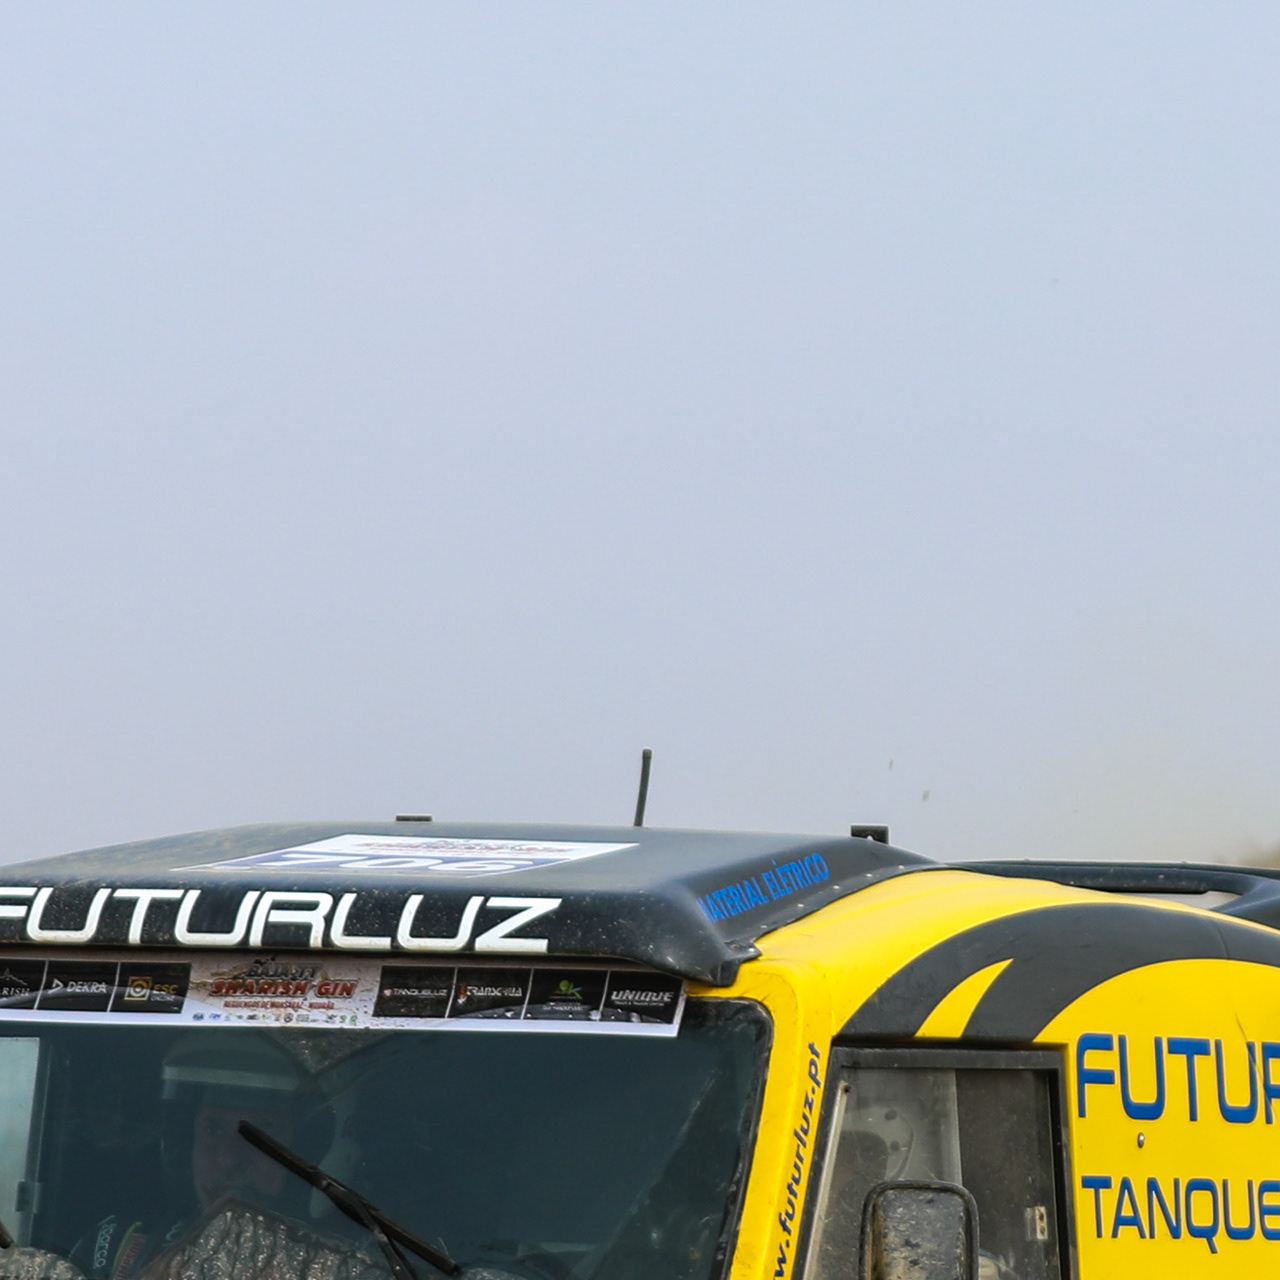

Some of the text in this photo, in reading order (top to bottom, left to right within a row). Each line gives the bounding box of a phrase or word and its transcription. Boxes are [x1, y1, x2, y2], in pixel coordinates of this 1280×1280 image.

[67, 981, 108, 994] DEKRA
[153, 984, 179, 995] ESC
[316, 980, 358, 998] GIN
[611, 989, 674, 1002] UNIQUE
